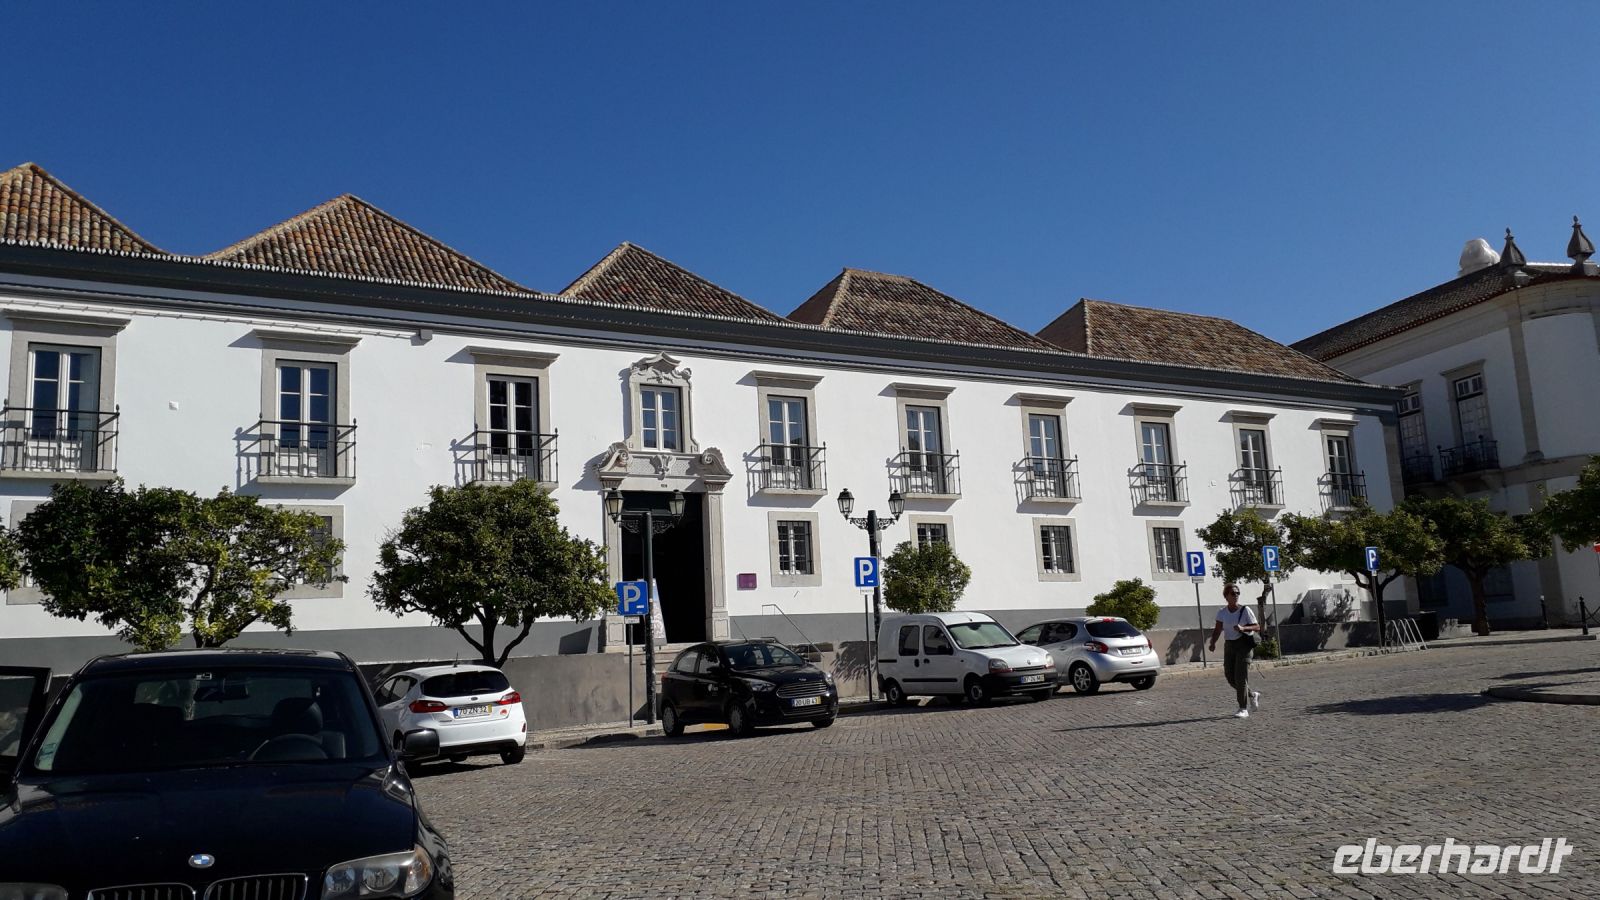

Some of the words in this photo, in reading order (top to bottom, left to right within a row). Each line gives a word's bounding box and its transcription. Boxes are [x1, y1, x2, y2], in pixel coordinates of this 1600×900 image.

[1190, 554, 1201, 574] P
[1266, 548, 1275, 568] P
[1369, 549, 1376, 568] P
[859, 559, 873, 584] P
[623, 585, 641, 612] P
